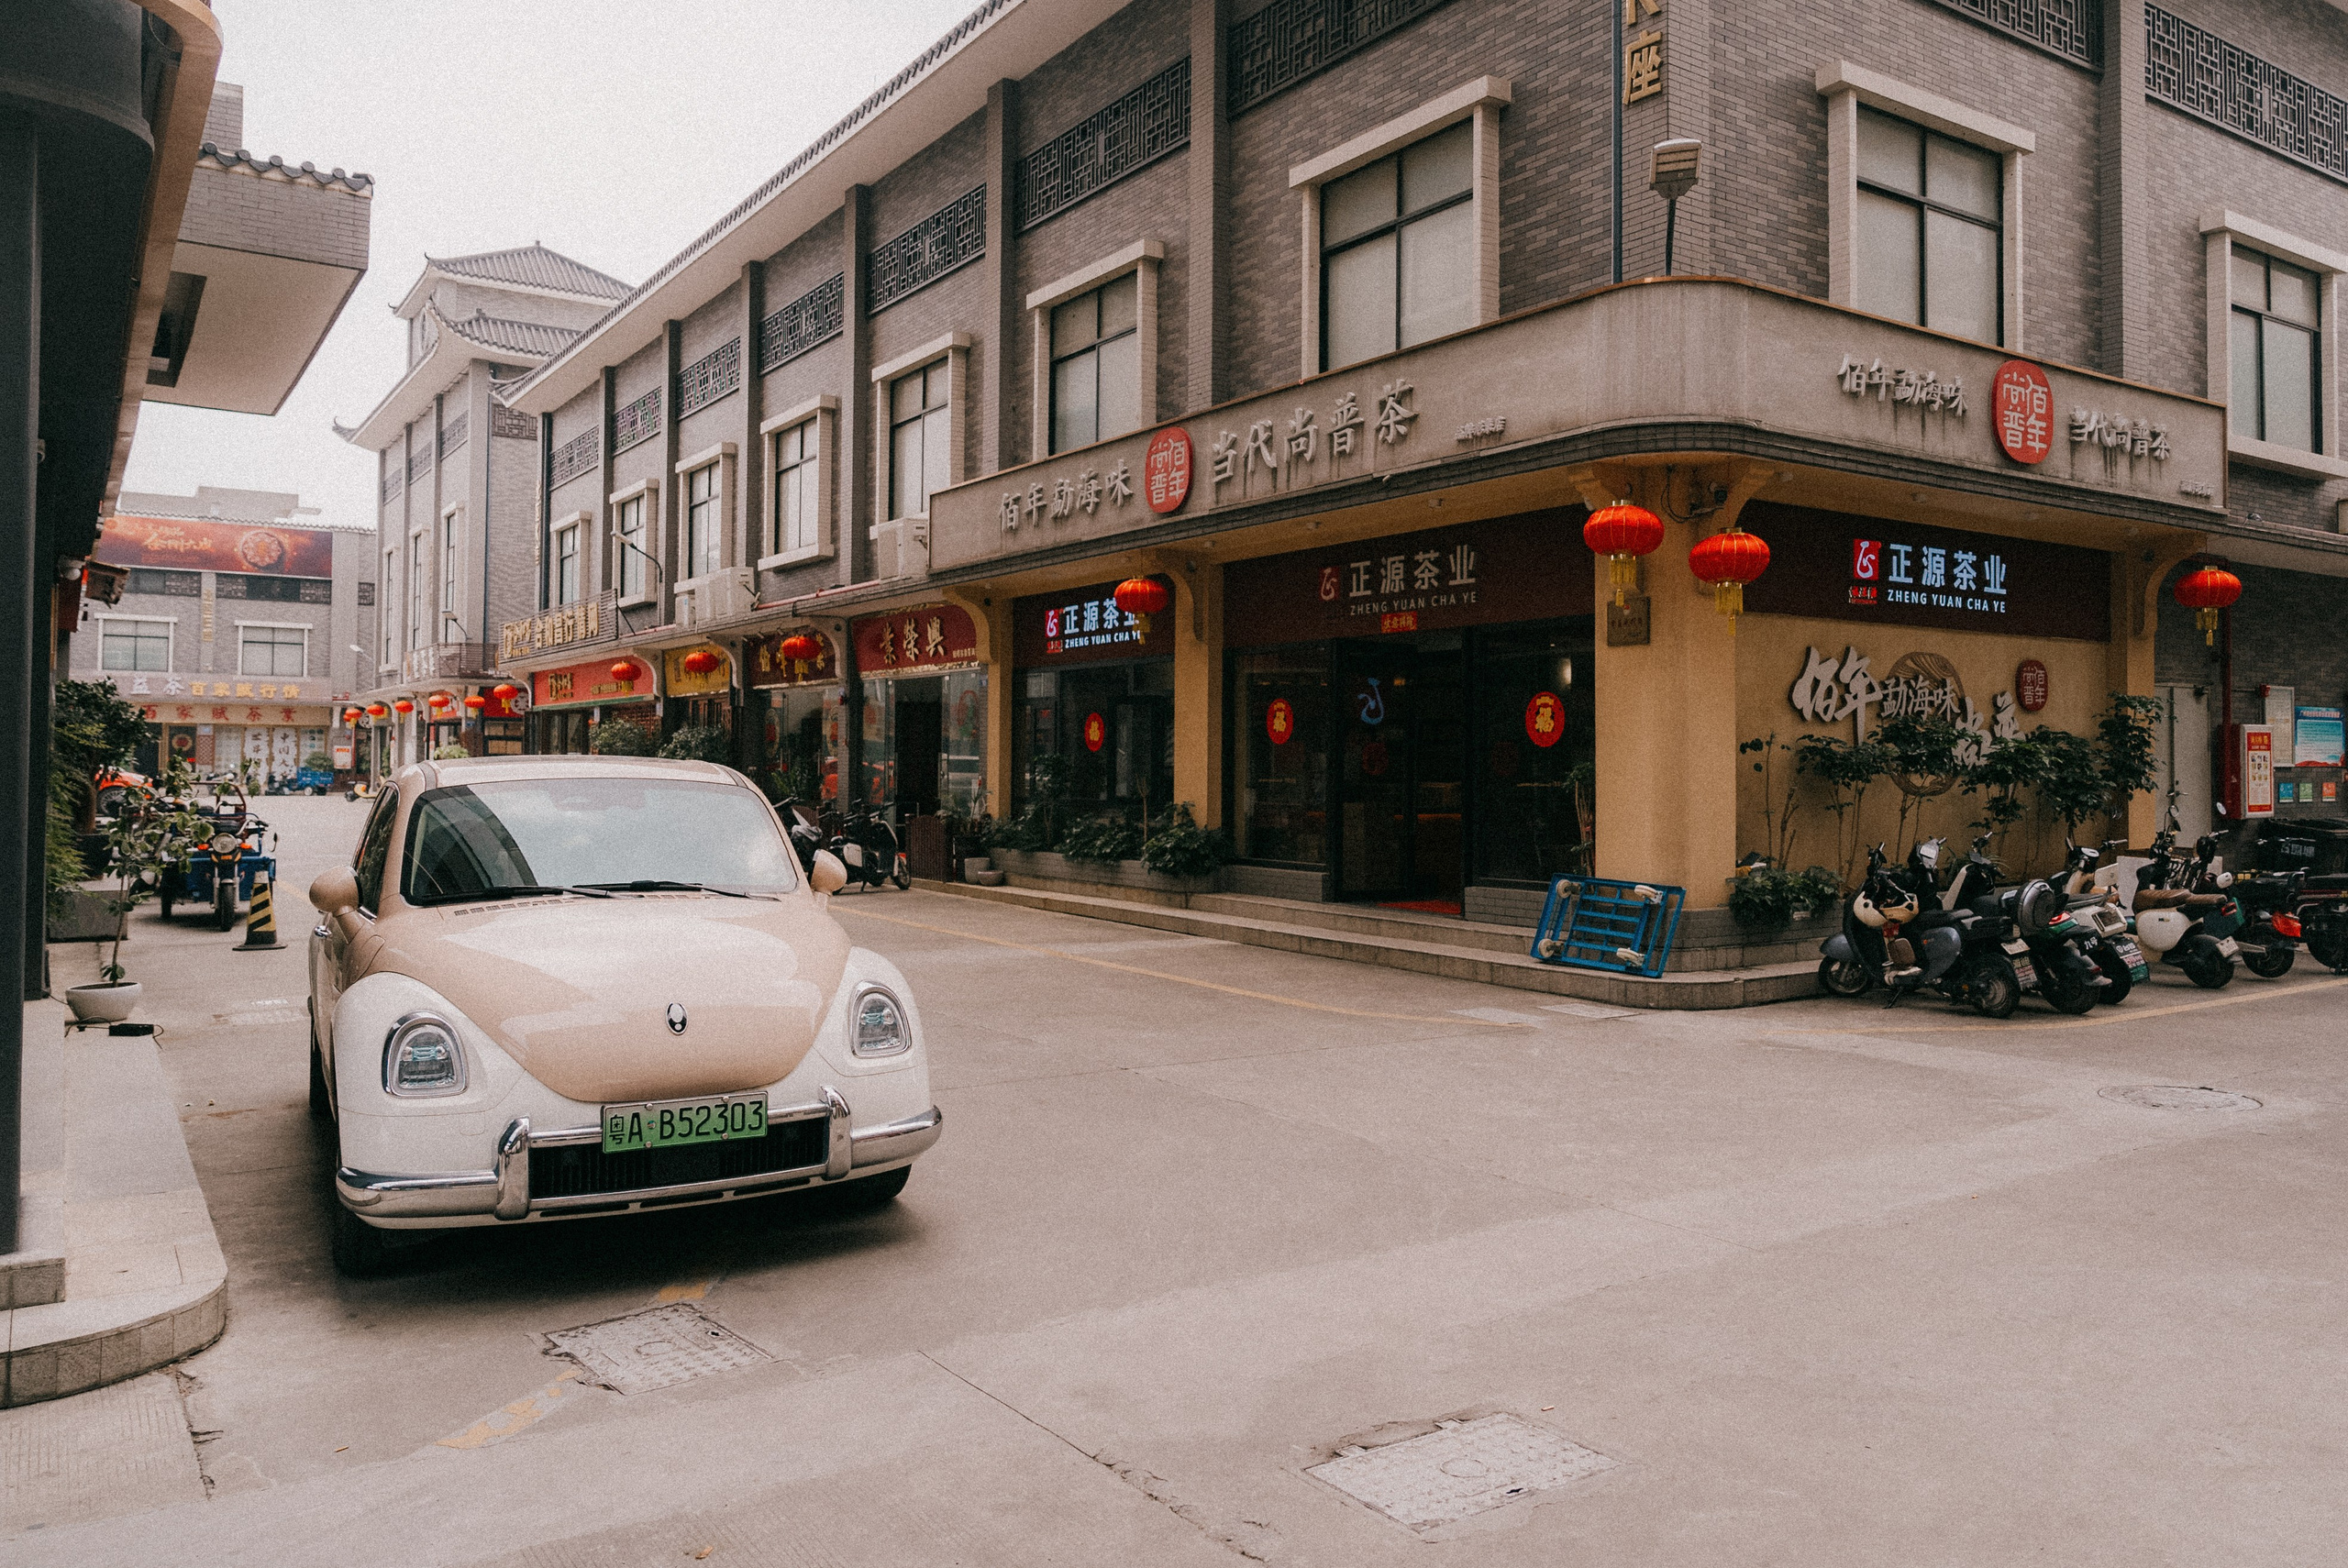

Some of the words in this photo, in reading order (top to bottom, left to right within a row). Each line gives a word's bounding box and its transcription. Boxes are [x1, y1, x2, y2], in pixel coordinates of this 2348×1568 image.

[1837, 354, 1968, 417] 佰年勐海味
[1212, 378, 1420, 484] 当代尚普茶
[998, 459, 1135, 534] 佰年勐海味
[1349, 544, 1477, 598] 正源茶业
[1888, 543, 2007, 595] 正源茶业
[1349, 601, 1389, 616] ZHENG
[1393, 597, 1425, 612] YUAN
[1431, 593, 1456, 607] CHA
[1462, 591, 1477, 603] YE
[1887, 589, 1927, 605] ZHENG
[1932, 593, 1963, 609] YUAN
[1966, 597, 1989, 612] CHA
[1993, 601, 2006, 613] YE
[1065, 636, 1090, 649] ZHENG
[1091, 633, 1112, 646] YUAN
[1113, 630, 1130, 642] CHA
